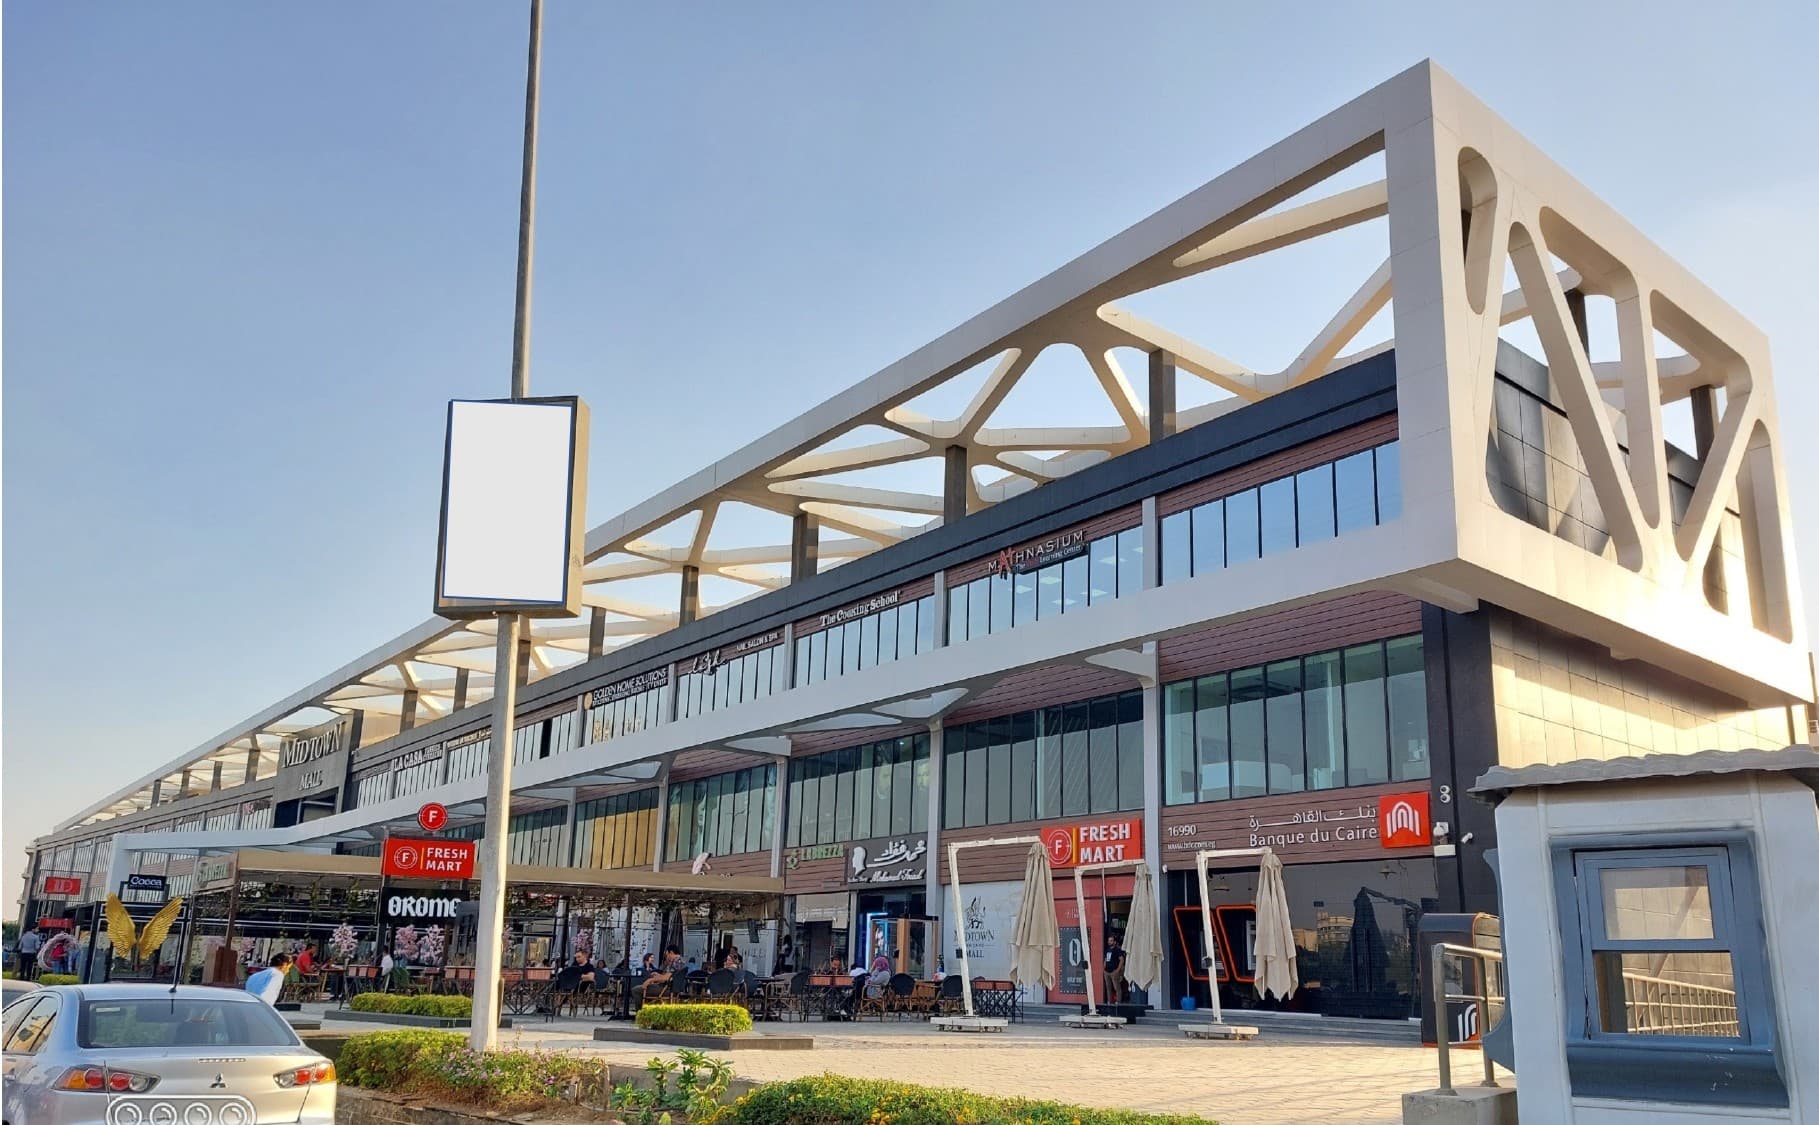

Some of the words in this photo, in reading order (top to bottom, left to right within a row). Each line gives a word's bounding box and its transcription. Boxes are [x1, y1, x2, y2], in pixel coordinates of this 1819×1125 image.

[988, 529, 1084, 574] MATHNASIUM
[820, 614, 837, 627] The
[837, 602, 870, 621] Cooking
[870, 590, 898, 610] School
[593, 684, 617, 700] GOLDEN
[617, 677, 635, 693] HOME
[635, 668, 667, 686] SOLUTIONS
[282, 721, 346, 769] MIDTOWN
[394, 756, 404, 771] LA
[404, 750, 423, 769] CASA
[299, 769, 322, 791] MALL
[428, 810, 438, 823] F
[1079, 822, 1132, 843] FRESH
[1167, 824, 1197, 837] 16990
[1250, 832, 1305, 848] Banque
[1310, 828, 1330, 843] du
[1336, 825, 1378, 841] Caire
[427, 847, 468, 859] FRESH
[1055, 839, 1063, 854] F
[1079, 844, 1126, 863] MART
[401, 852, 410, 863] F
[426, 860, 462, 872] MART
